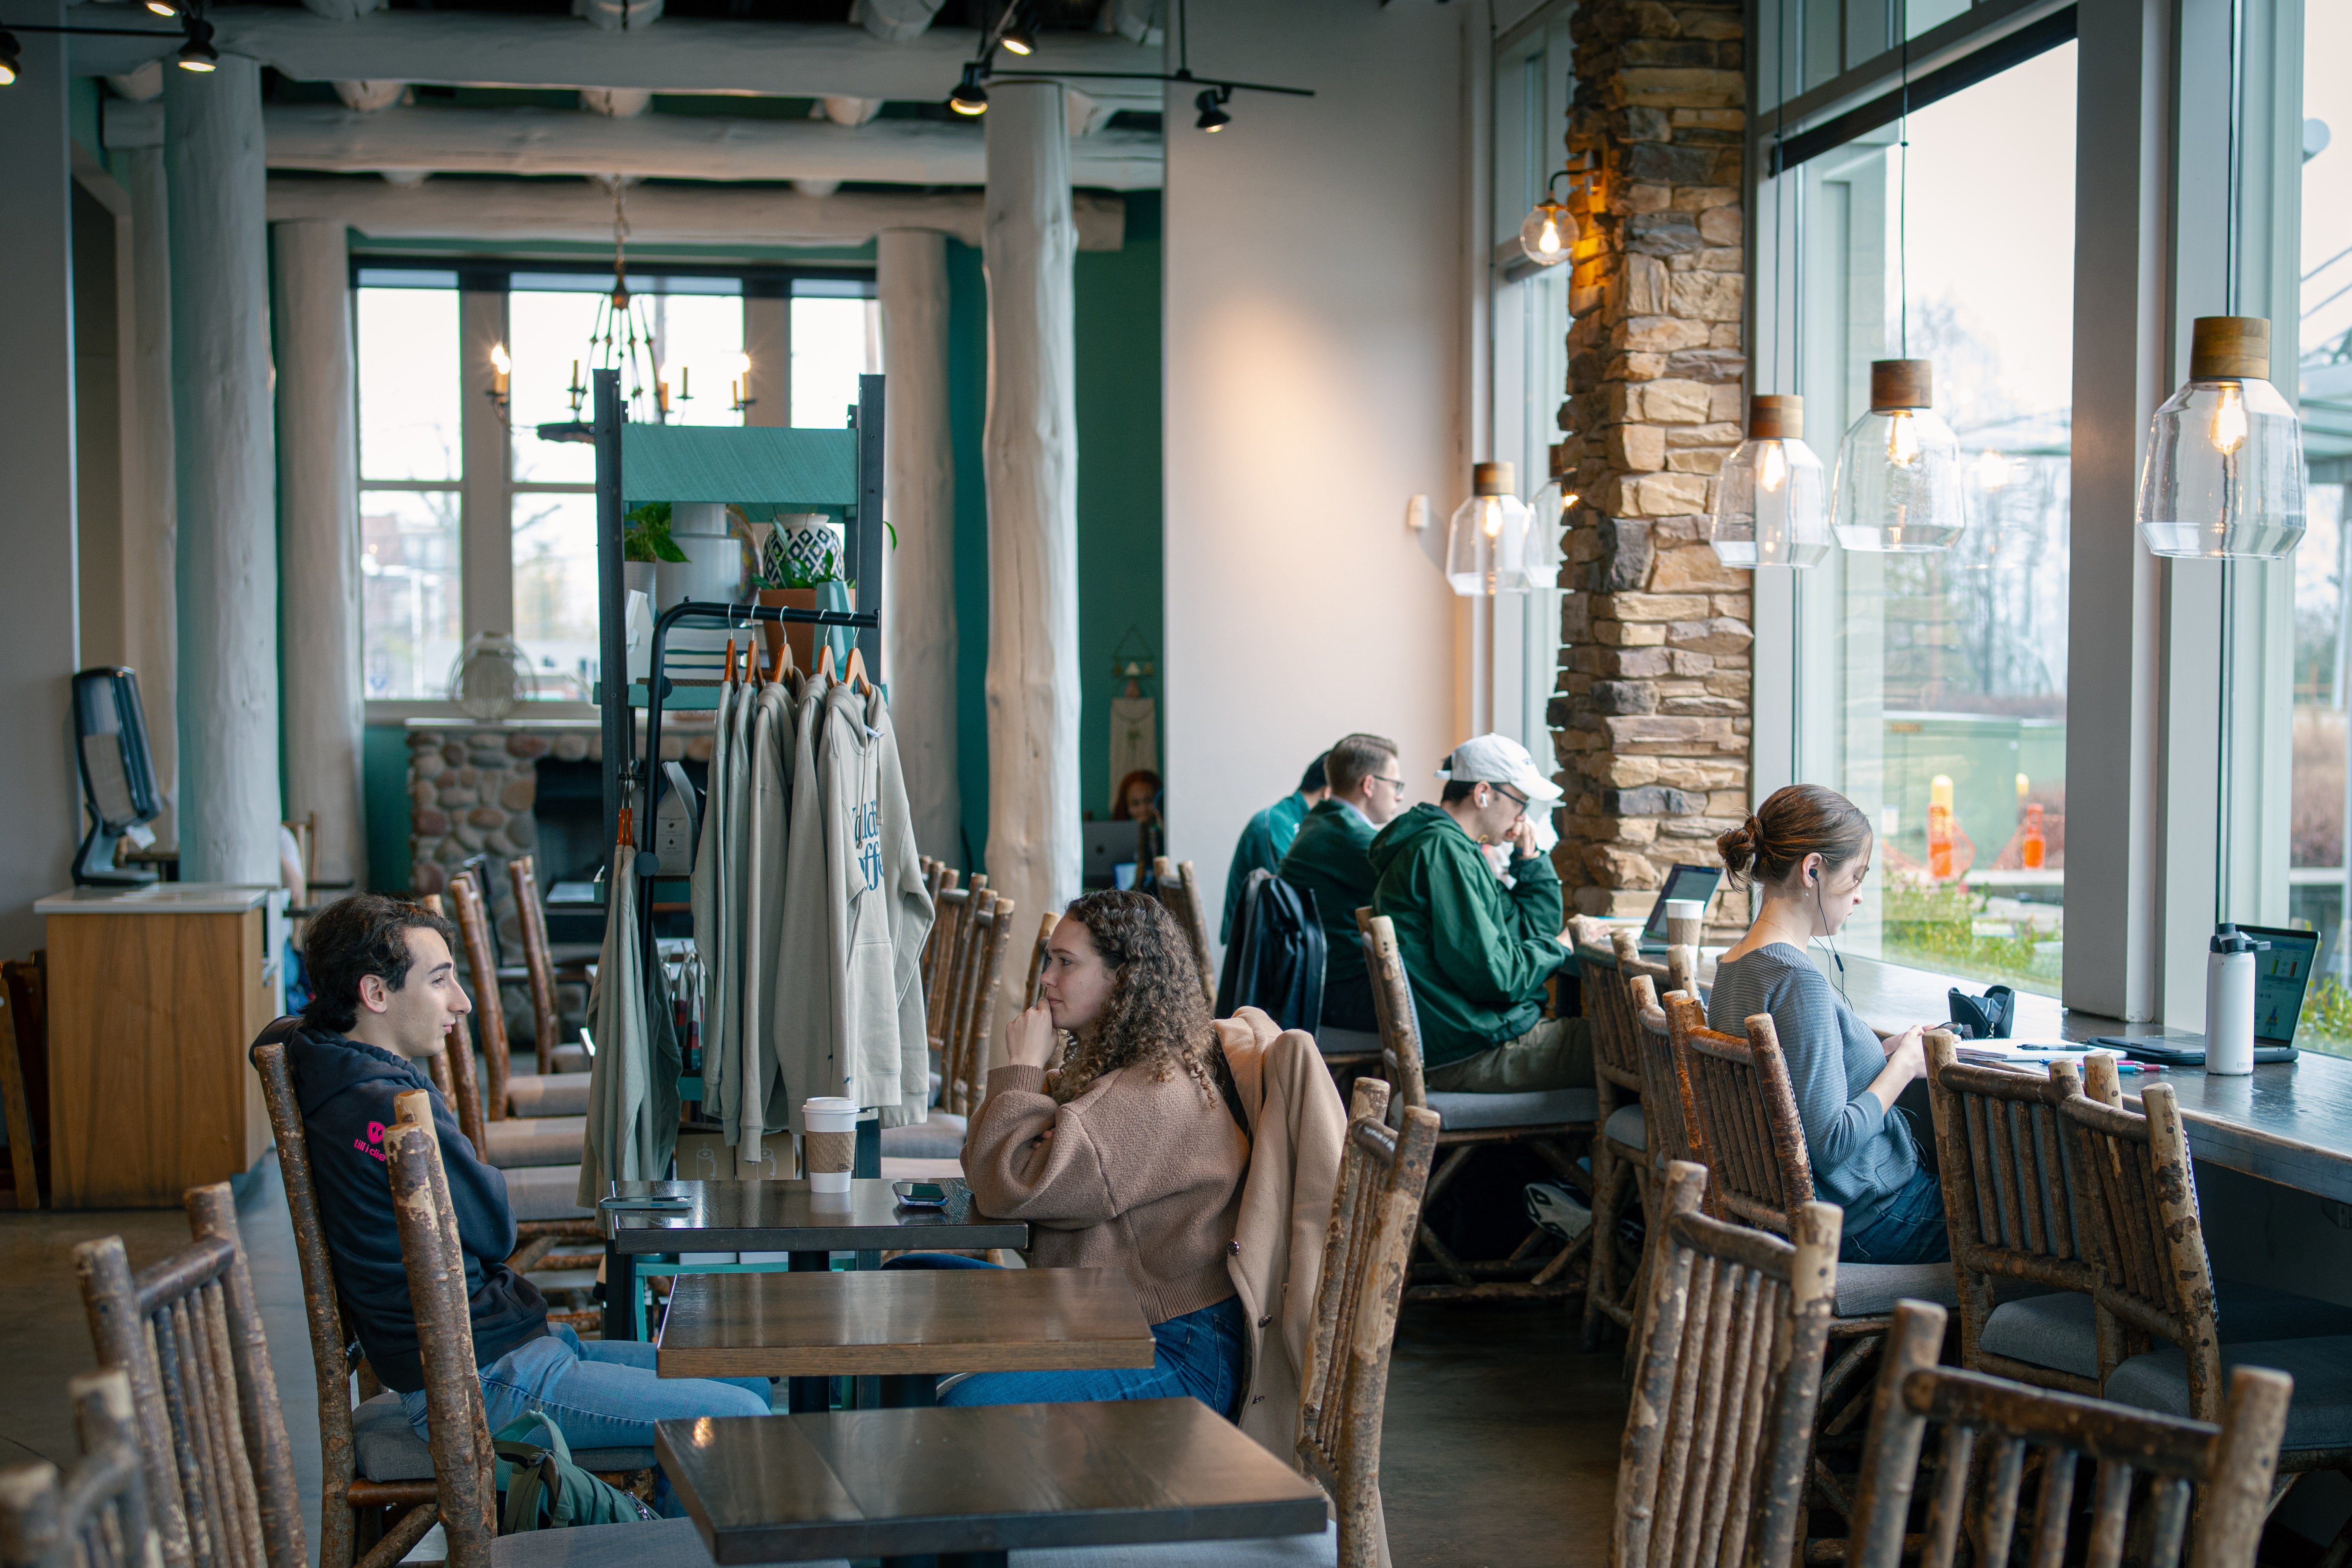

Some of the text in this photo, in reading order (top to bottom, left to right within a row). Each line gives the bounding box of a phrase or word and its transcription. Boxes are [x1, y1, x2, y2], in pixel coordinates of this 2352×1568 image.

[354, 1139, 386, 1161] till i die
